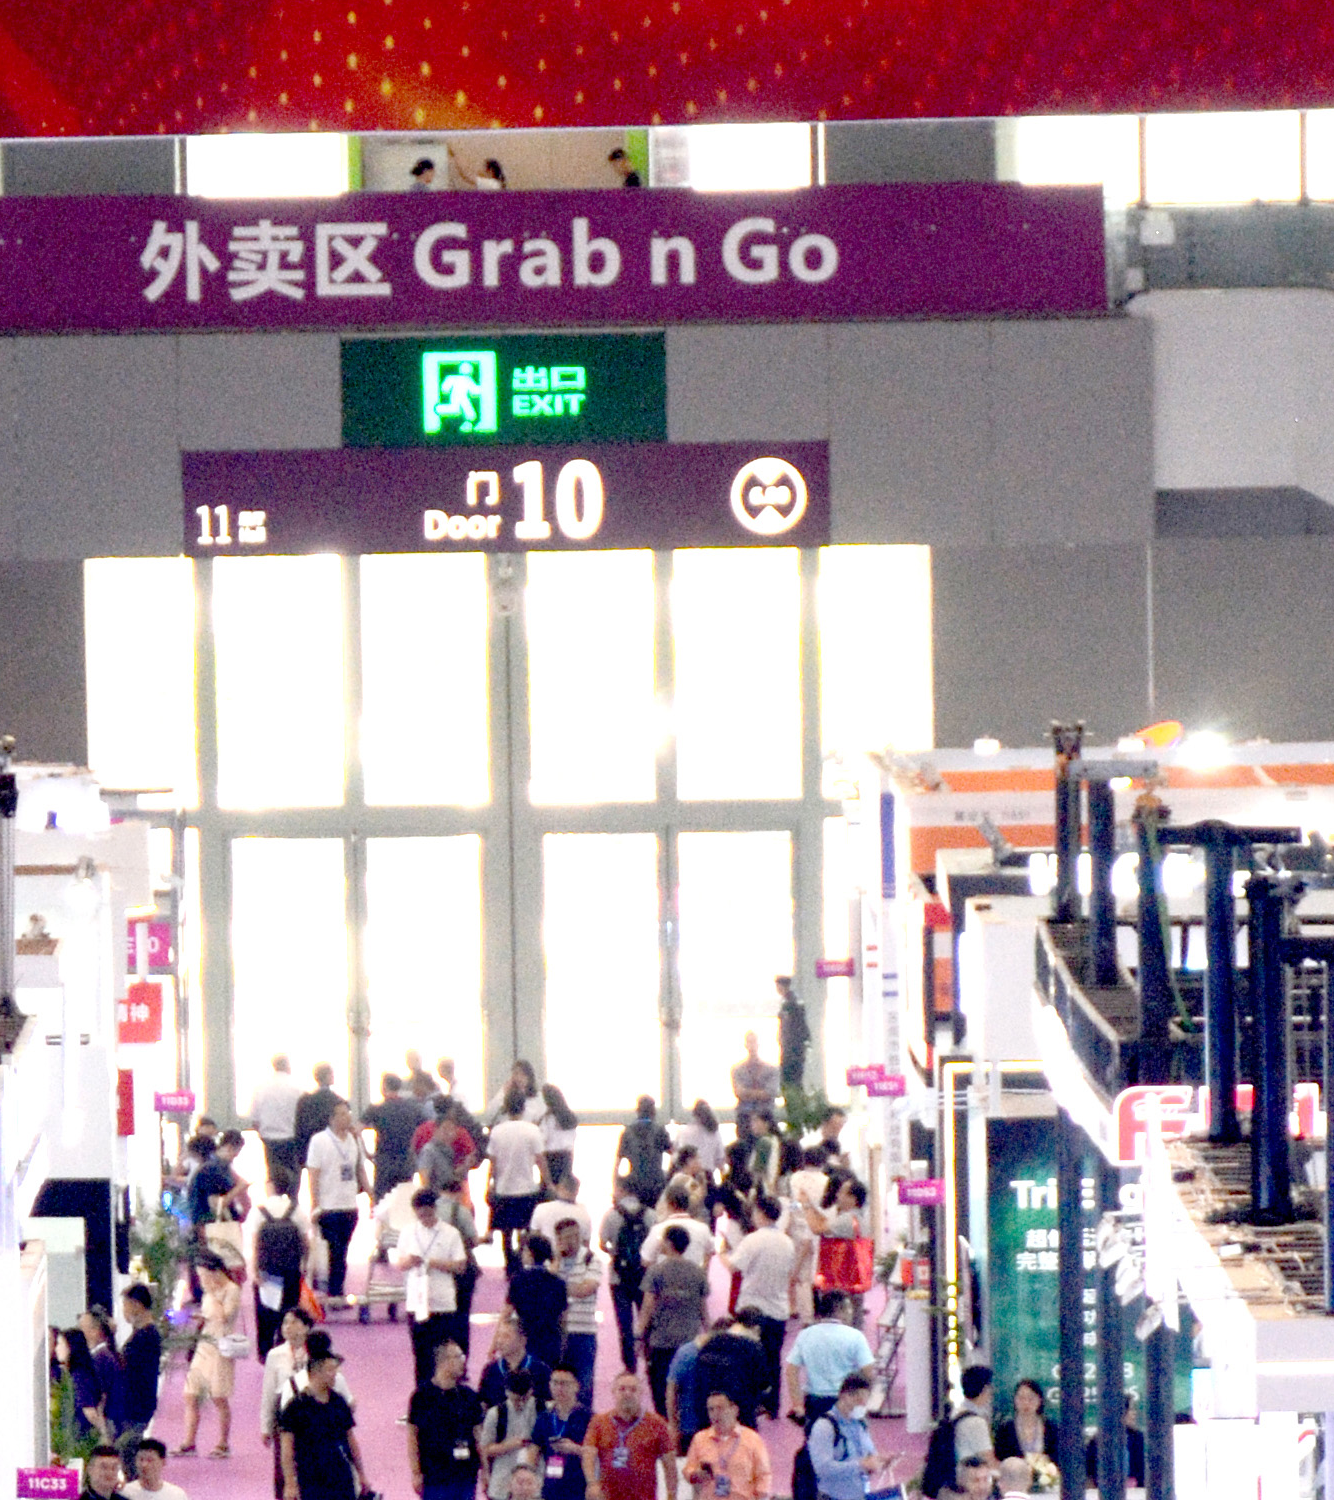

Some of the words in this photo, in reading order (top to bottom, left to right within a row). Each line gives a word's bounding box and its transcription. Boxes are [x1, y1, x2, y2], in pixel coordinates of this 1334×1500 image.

[139, 220, 392, 301] 外卖区
[413, 218, 622, 291] Grab
[651, 237, 696, 284] n
[722, 217, 840, 286] Go
[512, 365, 586, 392] 出口
[512, 394, 586, 417] EXIT
[423, 509, 502, 540] Door
[513, 458, 604, 540] 10
[466, 470, 500, 506] 门
[196, 504, 232, 545] 11
[28, 1476, 68, 1492] 11C33
